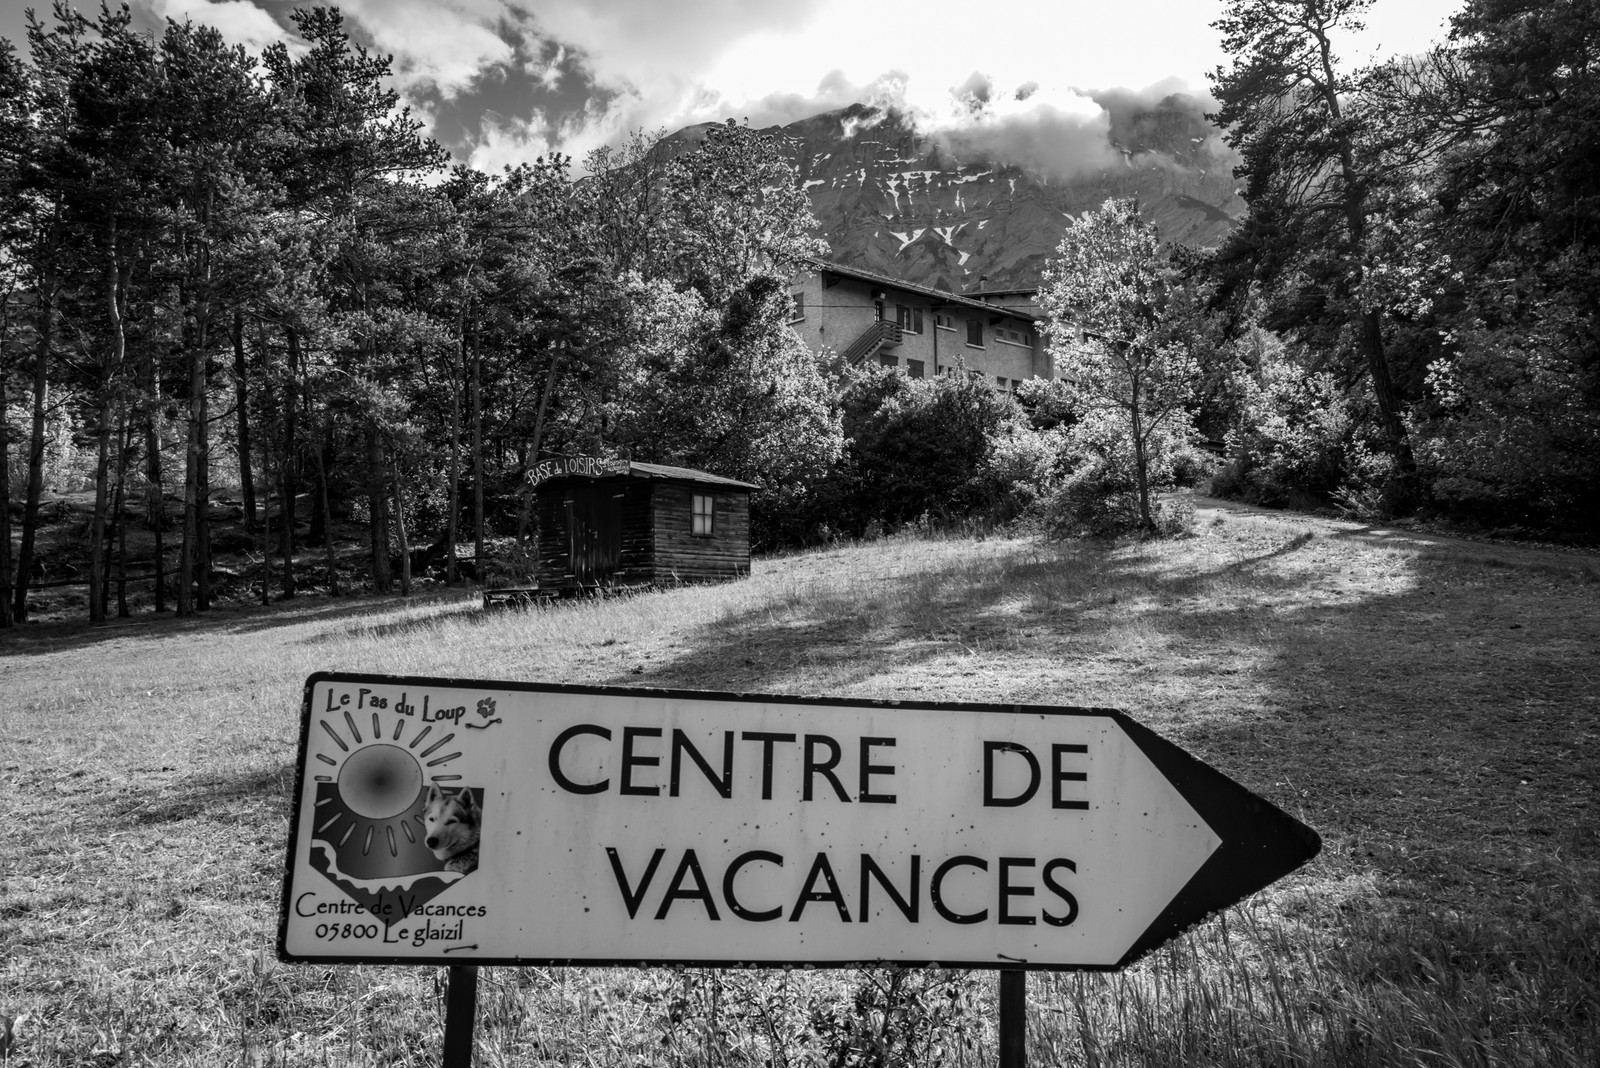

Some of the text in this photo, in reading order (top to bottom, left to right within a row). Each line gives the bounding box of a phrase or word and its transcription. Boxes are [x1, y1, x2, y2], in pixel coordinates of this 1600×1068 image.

[564, 457, 603, 475] LOISIRS
[326, 688, 466, 725] Le Pas du Loup
[548, 724, 1090, 810] CENTRE DE
[605, 847, 1080, 928] VACANCES
[296, 892, 487, 919] Centre de Vacances
[315, 919, 464, 947] 05800 Le glaizil
